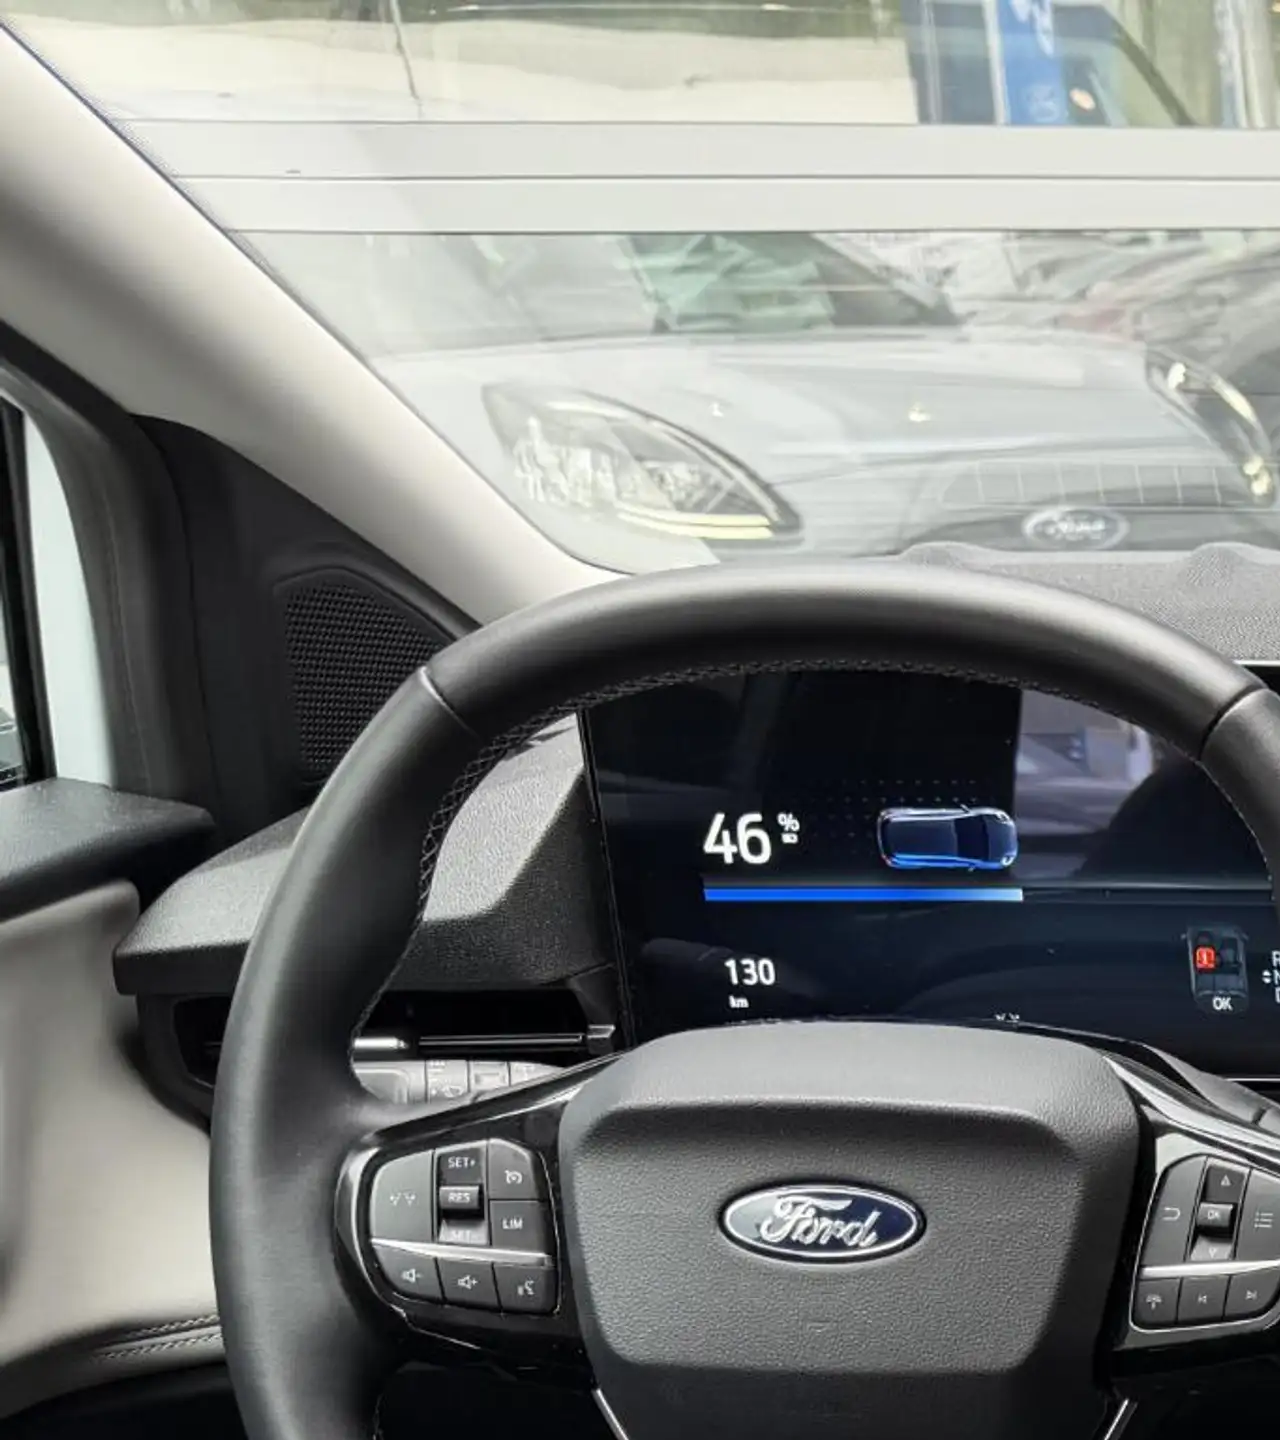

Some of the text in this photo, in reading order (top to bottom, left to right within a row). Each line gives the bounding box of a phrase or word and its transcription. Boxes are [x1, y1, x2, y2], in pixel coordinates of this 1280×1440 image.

[703, 812, 773, 865] 46
[725, 958, 776, 986] 130
[729, 995, 750, 1008] km
[1212, 996, 1234, 1011] OK
[448, 1191, 471, 1204] RES
[760, 1195, 882, 1248] Ford
[1207, 1210, 1221, 1220] OK
[502, 1218, 524, 1230] LIM
